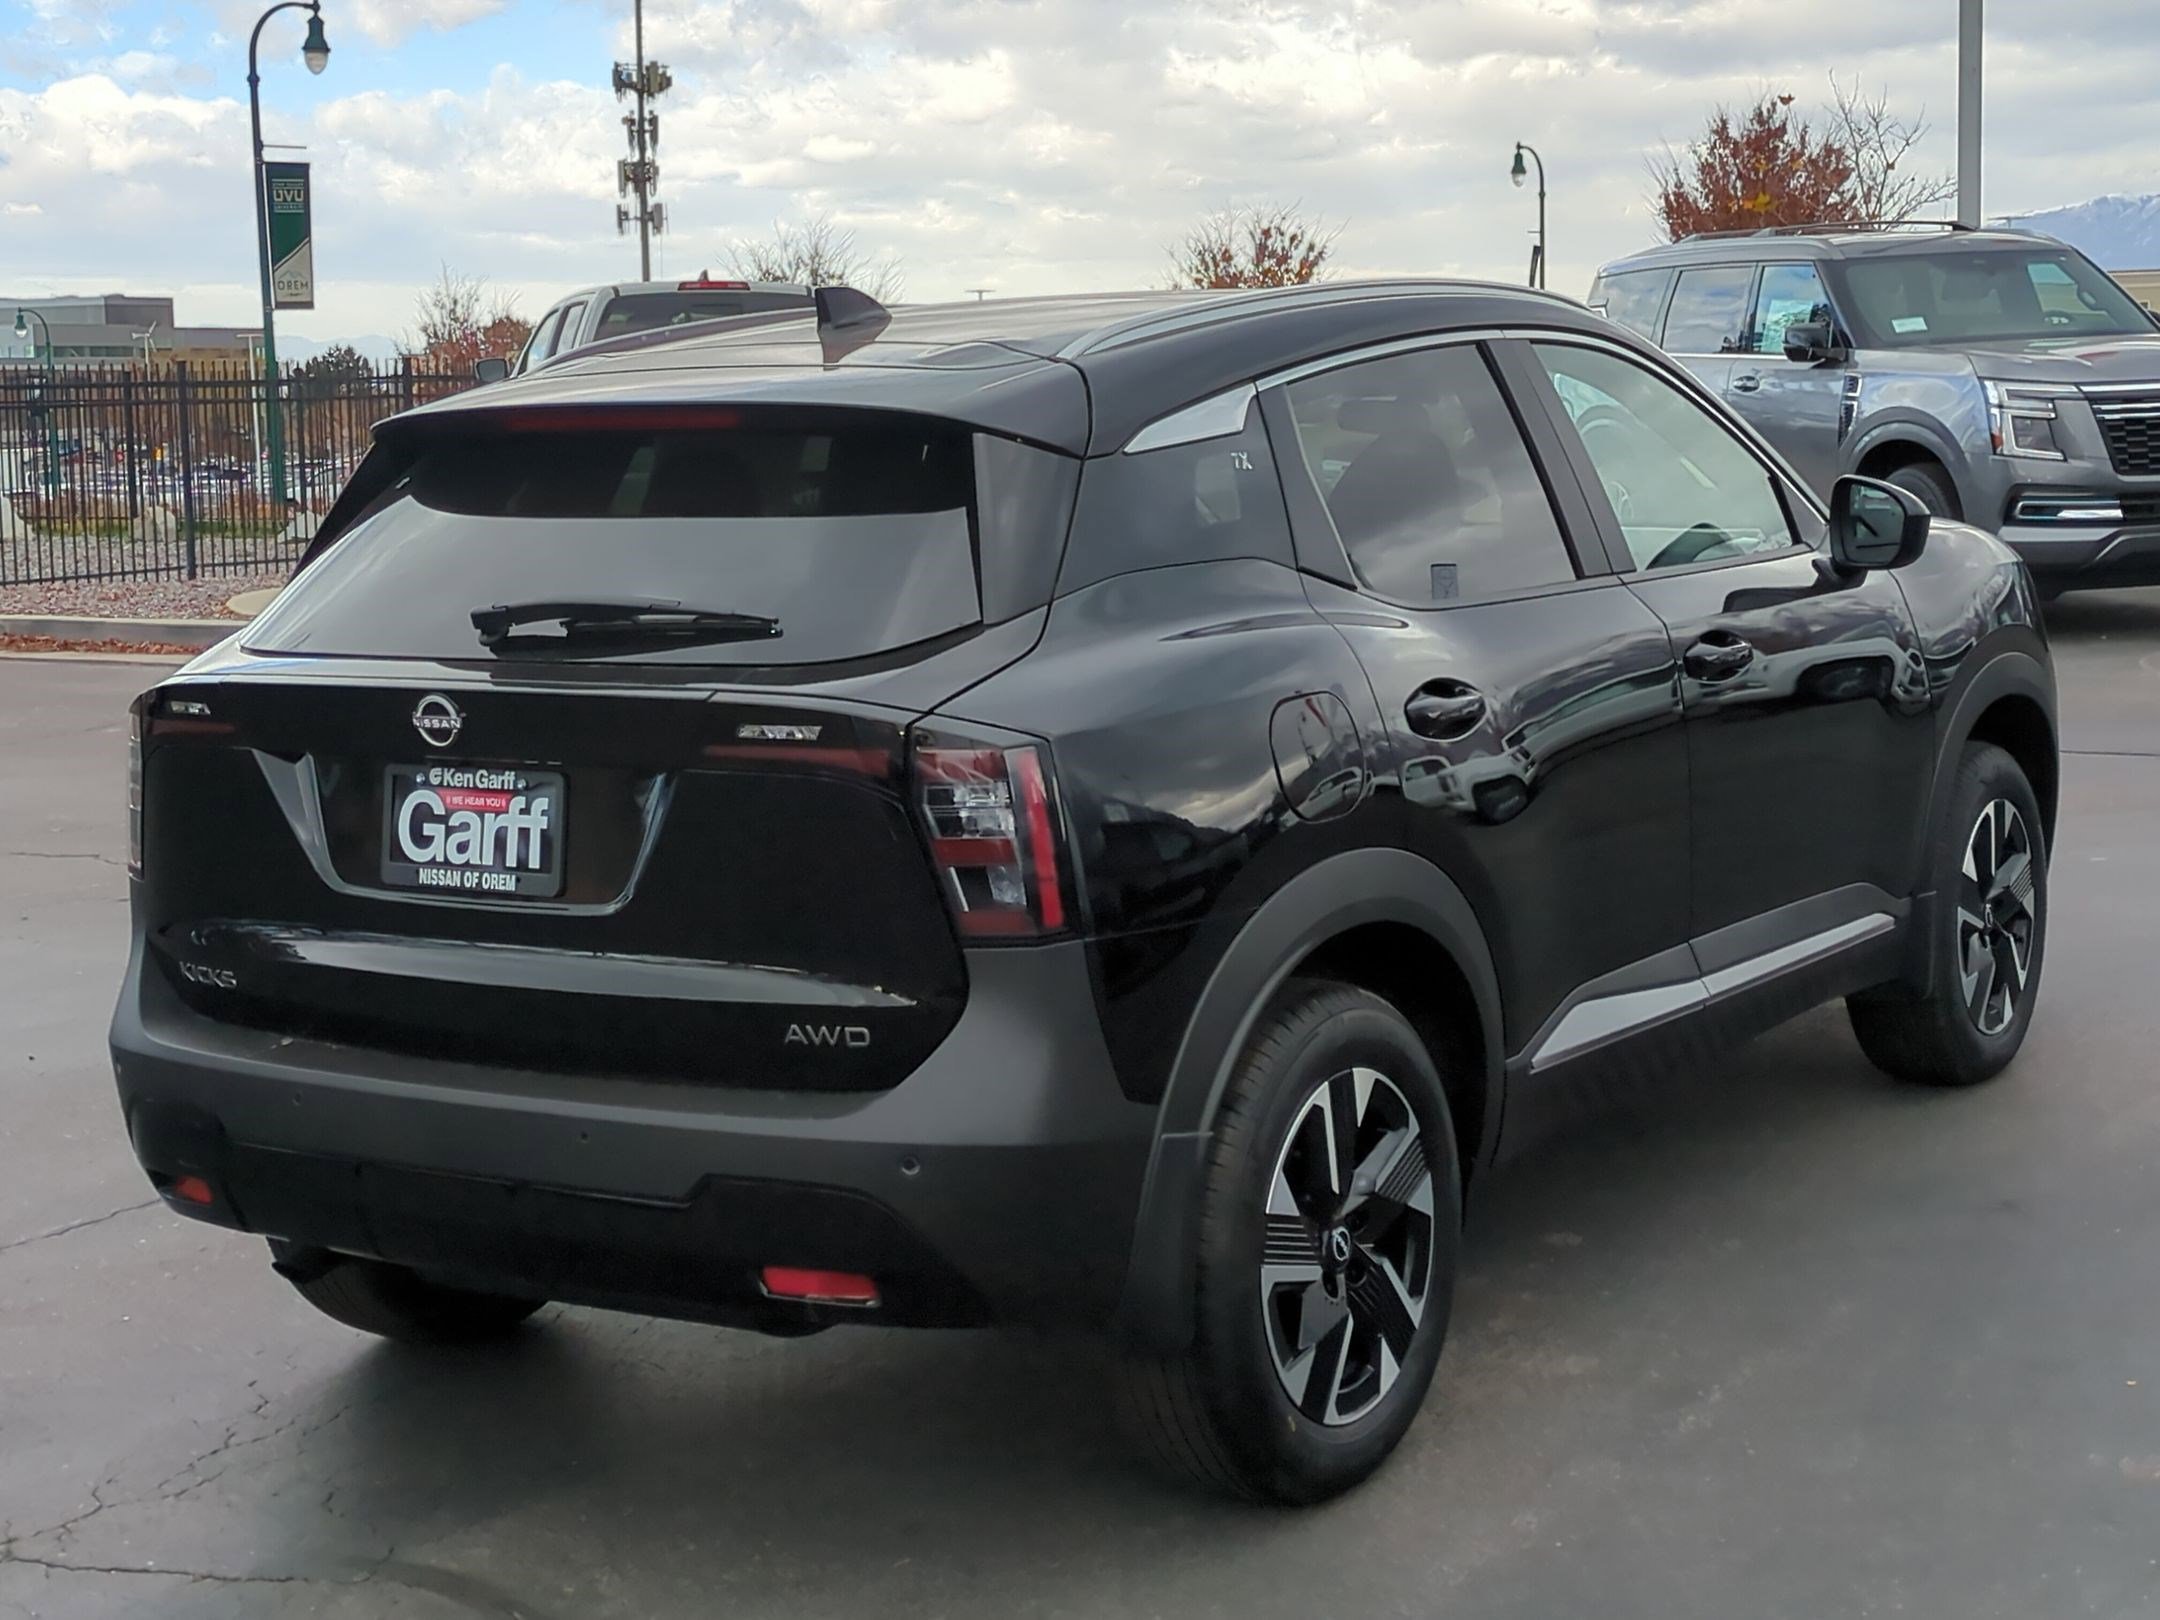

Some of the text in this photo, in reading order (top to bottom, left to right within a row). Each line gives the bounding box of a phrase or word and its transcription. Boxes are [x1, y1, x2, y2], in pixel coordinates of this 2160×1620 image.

[273, 189, 304, 202] UVU
[277, 280, 309, 291] OREM
[412, 717, 461, 729] NISSAN
[443, 768, 516, 790] Ken Garff
[451, 796, 501, 808] WE HEAR YOU
[398, 789, 549, 869] Garff
[418, 868, 516, 891] NISSAN OF OREM
[179, 961, 237, 988] KICKS
[784, 1023, 870, 1047] AWD
